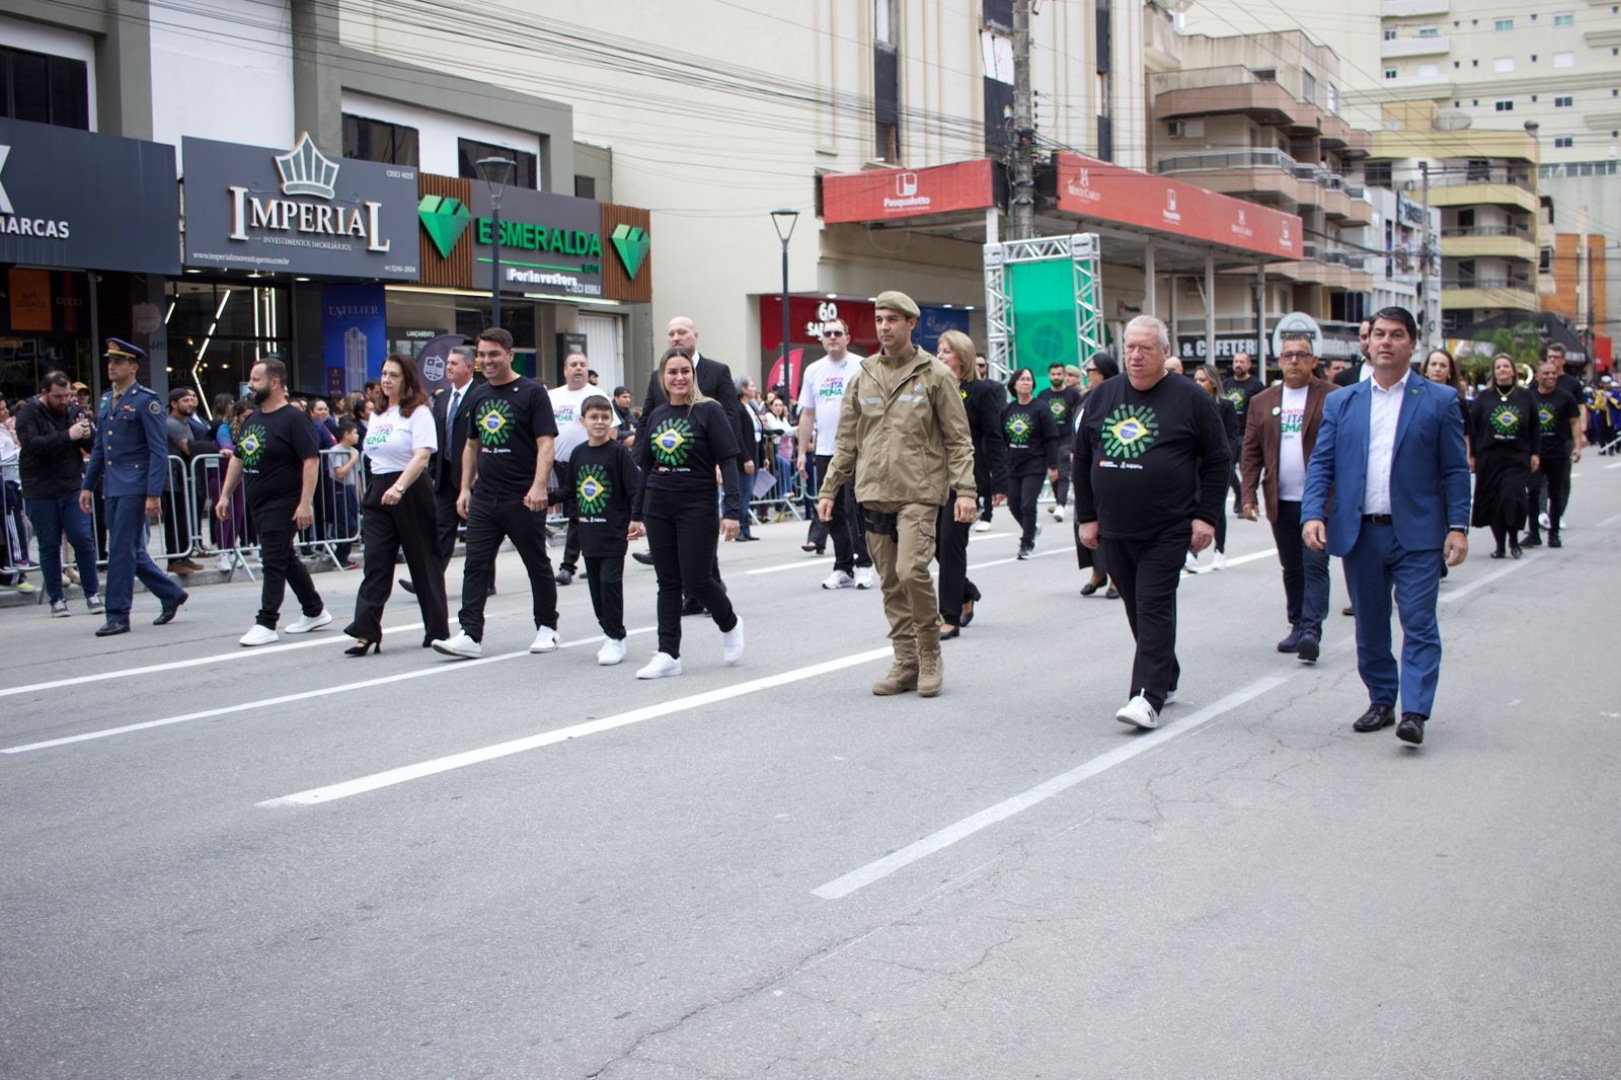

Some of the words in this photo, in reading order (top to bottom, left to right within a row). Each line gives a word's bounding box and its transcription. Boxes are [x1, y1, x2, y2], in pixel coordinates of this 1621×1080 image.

[228, 186, 390, 252] IMPERIAL
[263, 236, 311, 248] INVESTIMENTOS
[312, 240, 352, 251] IMOBILIÁRIOS
[478, 217, 603, 257] ESMERALDA
[818, 302, 838, 321] 60
